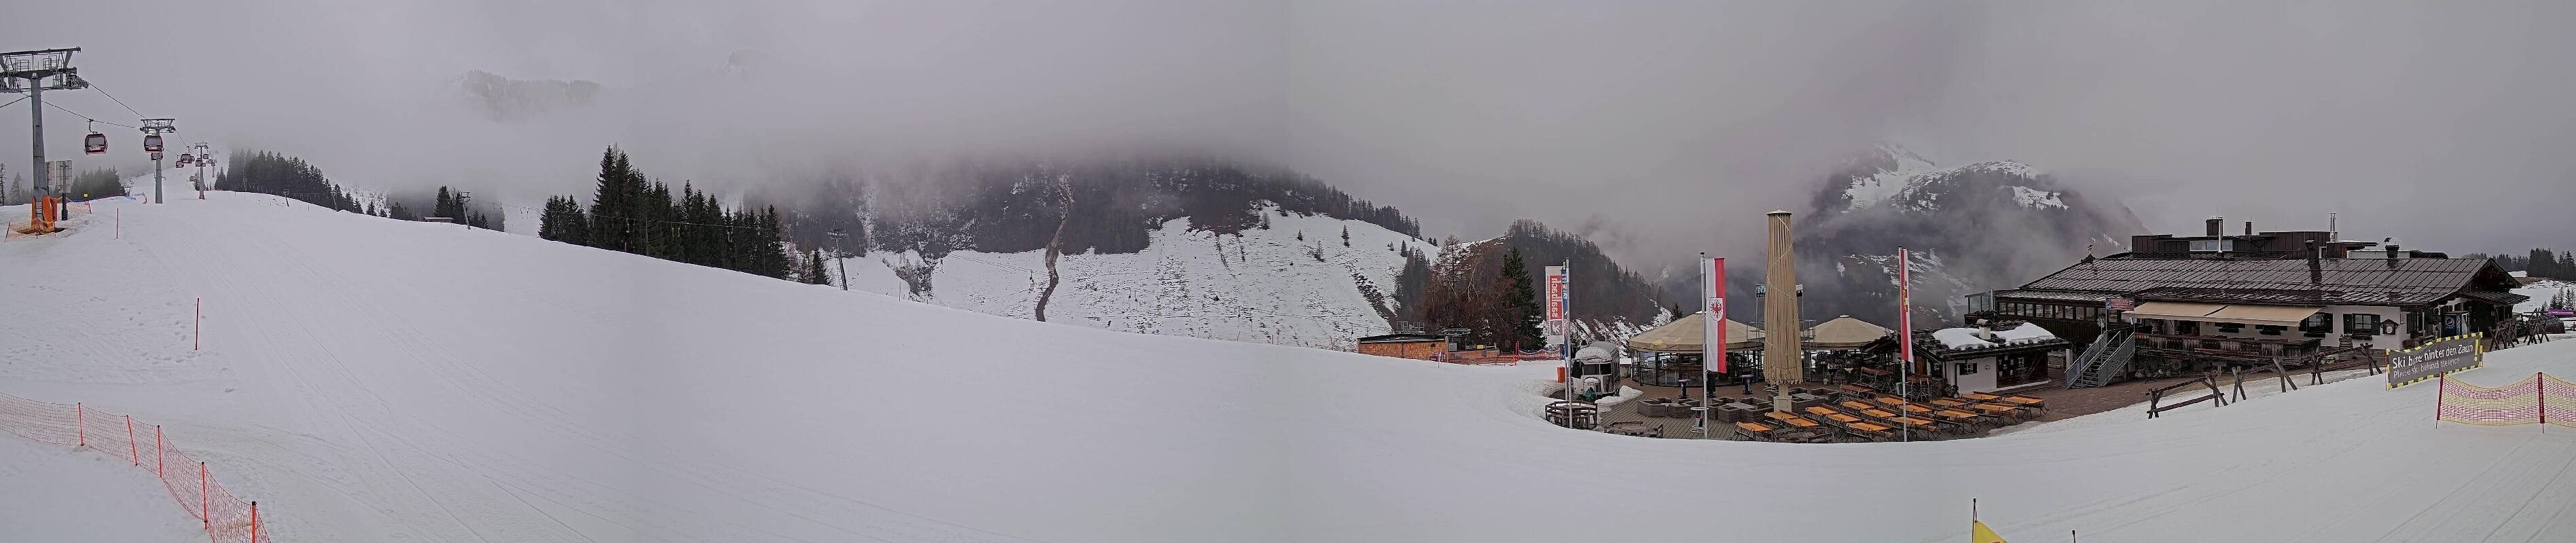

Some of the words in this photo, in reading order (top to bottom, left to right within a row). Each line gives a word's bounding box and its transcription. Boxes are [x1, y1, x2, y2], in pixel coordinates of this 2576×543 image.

[2393, 356, 2406, 369] Ski
[2424, 350, 2445, 361] hinter
[2446, 347, 2457, 356] den
[2459, 344, 2473, 354] Zaun
[2412, 366, 2420, 374] ski
[2420, 360, 2439, 371] behind
